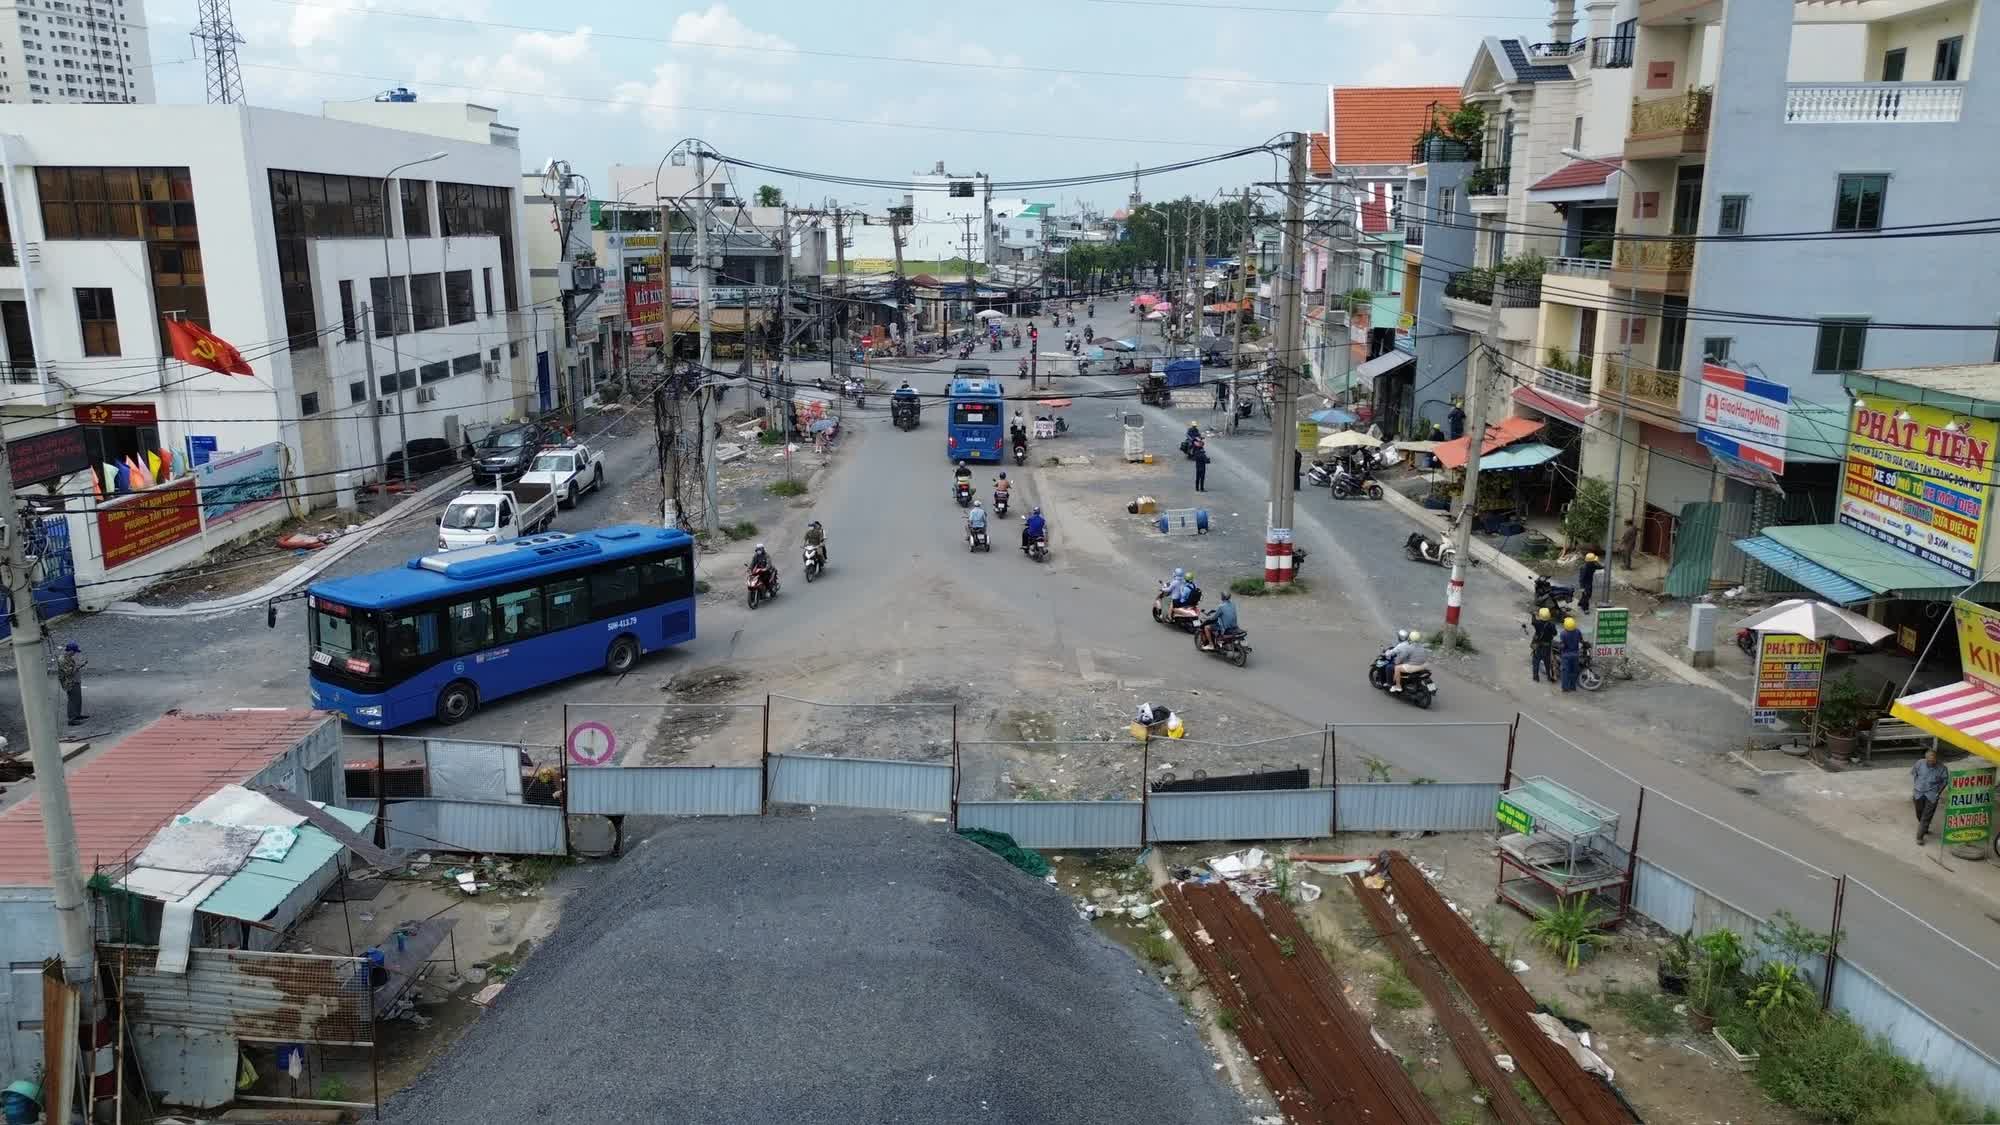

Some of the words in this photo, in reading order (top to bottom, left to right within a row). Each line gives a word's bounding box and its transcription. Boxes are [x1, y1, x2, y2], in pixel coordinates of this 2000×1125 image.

[1855, 408, 1919, 453] PHÁT
[1924, 421, 1991, 475] TIẾN
[1874, 469, 1886, 483] XE
[1886, 471, 1897, 487] SỐ
[1951, 793, 1973, 806] RAU
